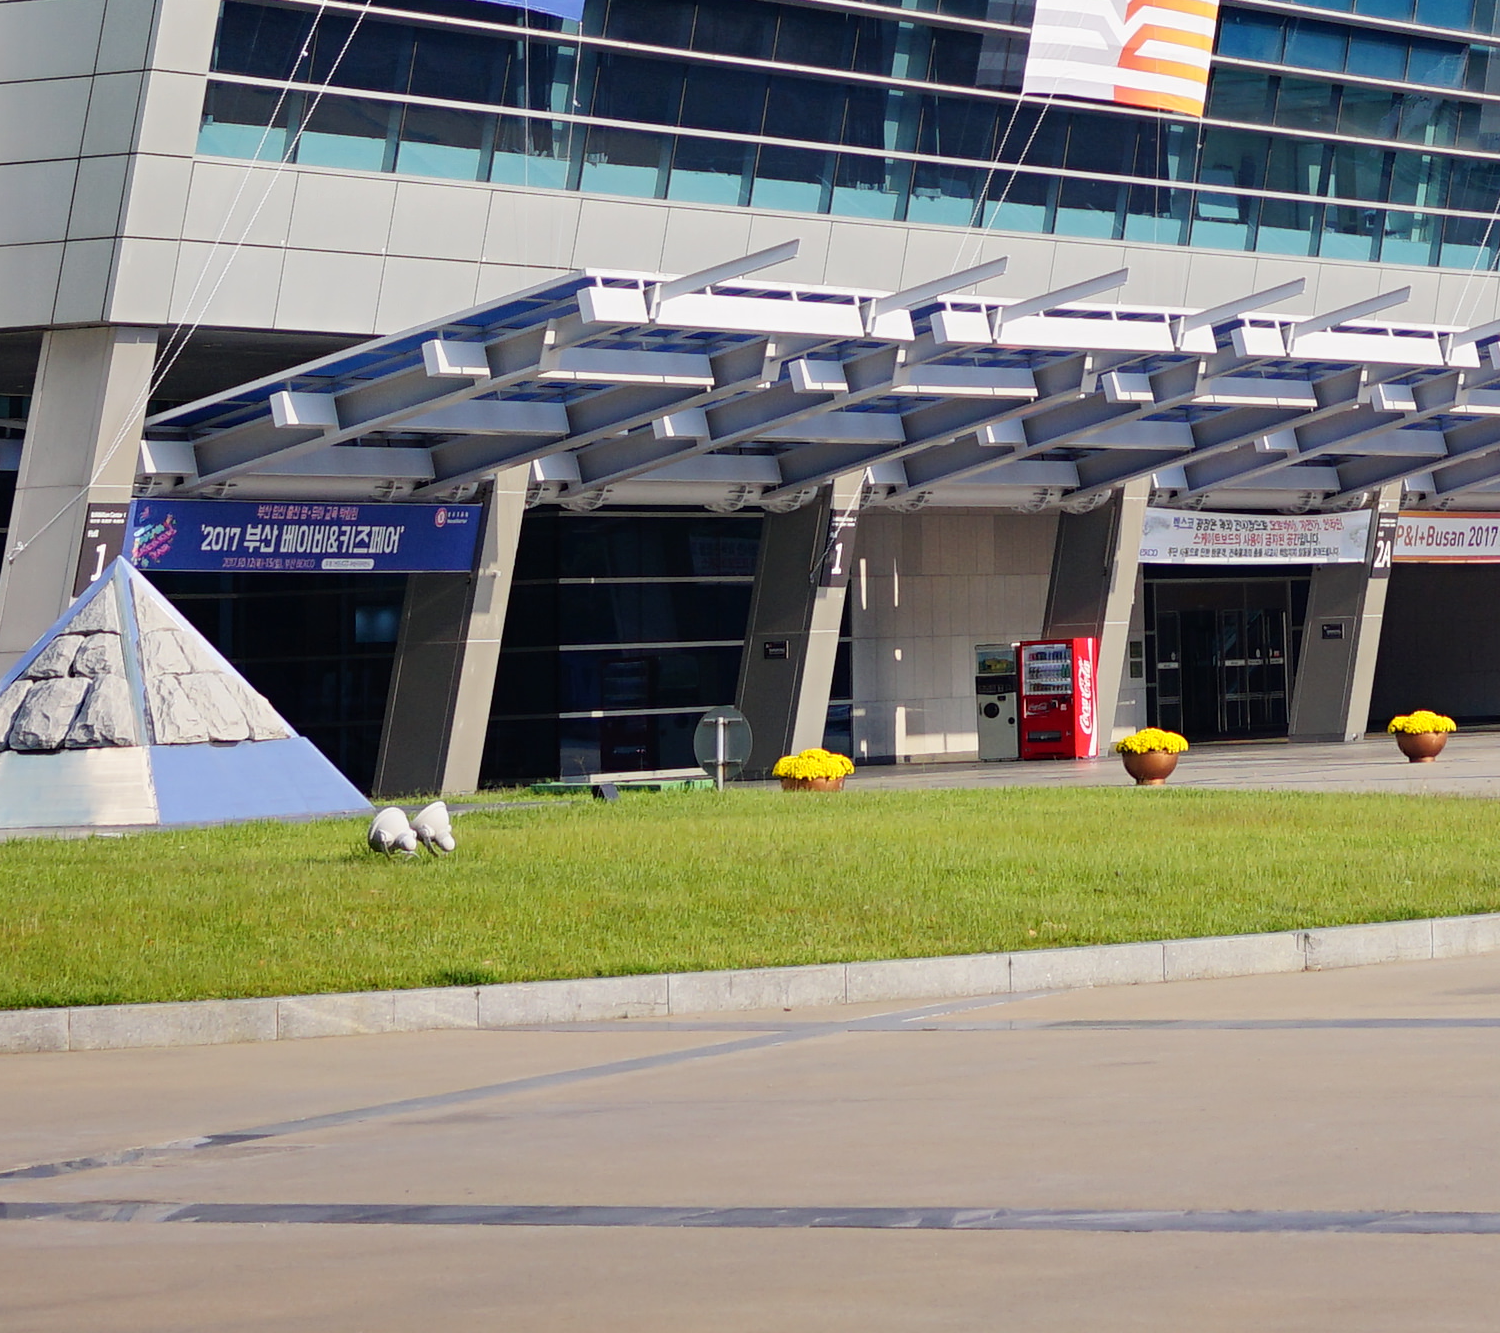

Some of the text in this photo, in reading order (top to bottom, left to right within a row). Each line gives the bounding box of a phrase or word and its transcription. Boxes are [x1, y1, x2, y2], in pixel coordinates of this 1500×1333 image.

[1172, 516, 1195, 530] 벡스코
[1395, 524, 1499, 548] P&I+Busan 2017
[243, 523, 280, 554] 부산
[1192, 532, 1242, 547] 스케이트보드의
[1242, 532, 1265, 547] 사용이
[1264, 532, 1285, 547] 금지된
[90, 543, 107, 582] 1
[831, 542, 843, 575] 1
[1373, 540, 1392, 568] 2A
